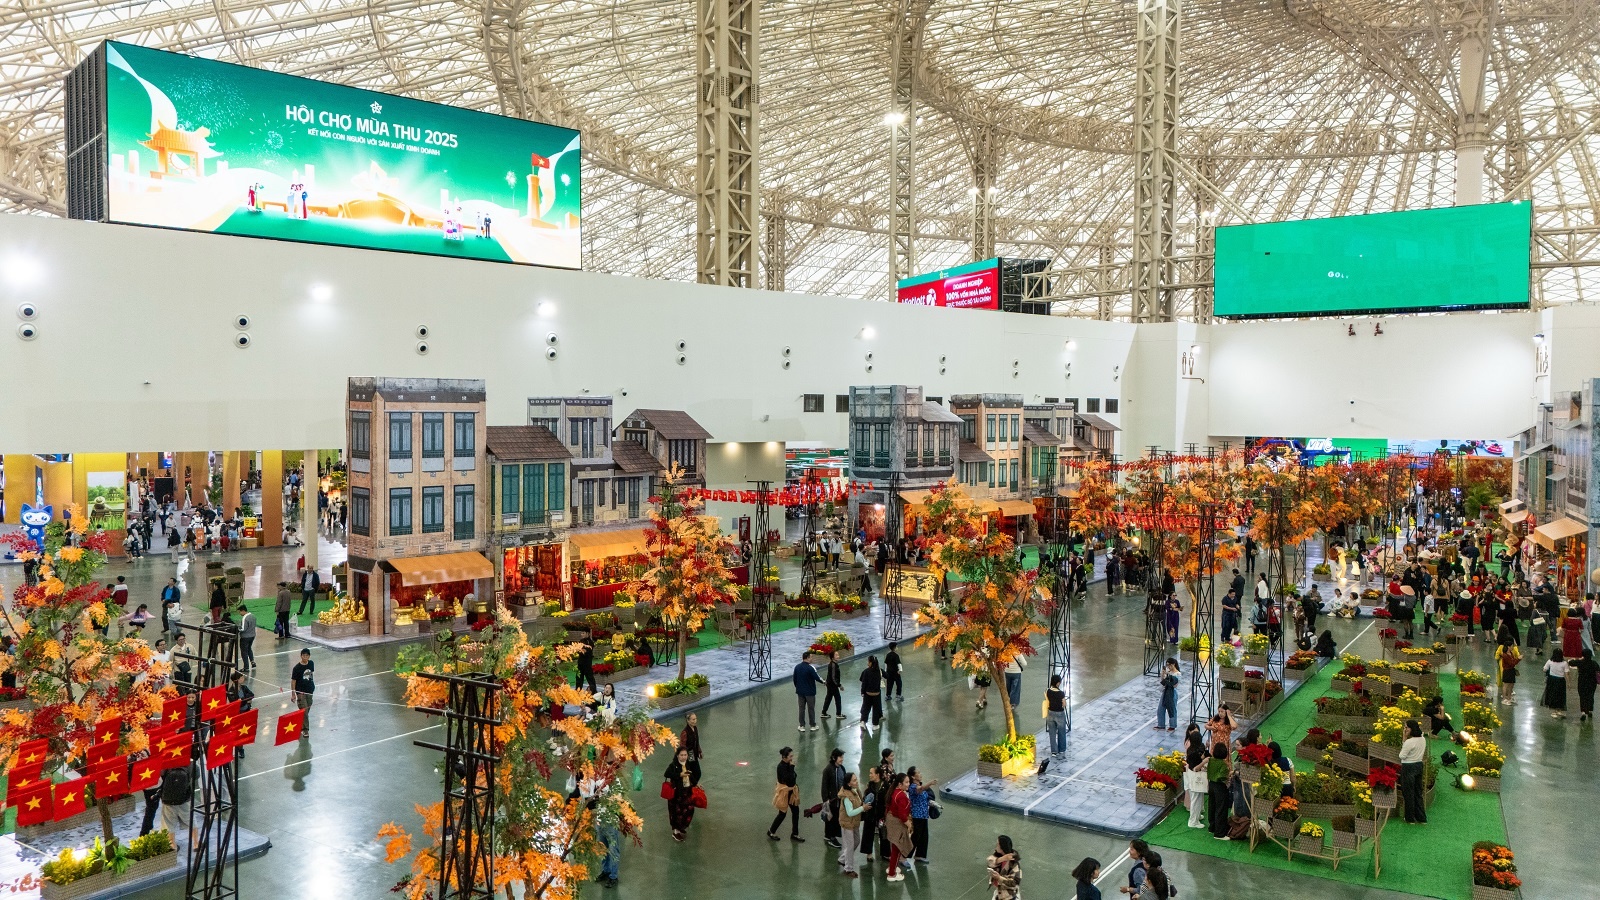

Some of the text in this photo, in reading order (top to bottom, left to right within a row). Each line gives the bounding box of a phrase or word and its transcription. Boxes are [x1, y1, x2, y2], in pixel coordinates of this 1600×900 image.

[286, 104, 459, 148] HỘI CHỢ MÙA THU 2025
[307, 127, 319, 136] KẾT
[320, 129, 332, 138] NỐI
[332, 132, 346, 141] CON
[406, 144, 420, 153] KINH
[420, 147, 441, 156] DOANH
[946, 291, 960, 301] 100%
